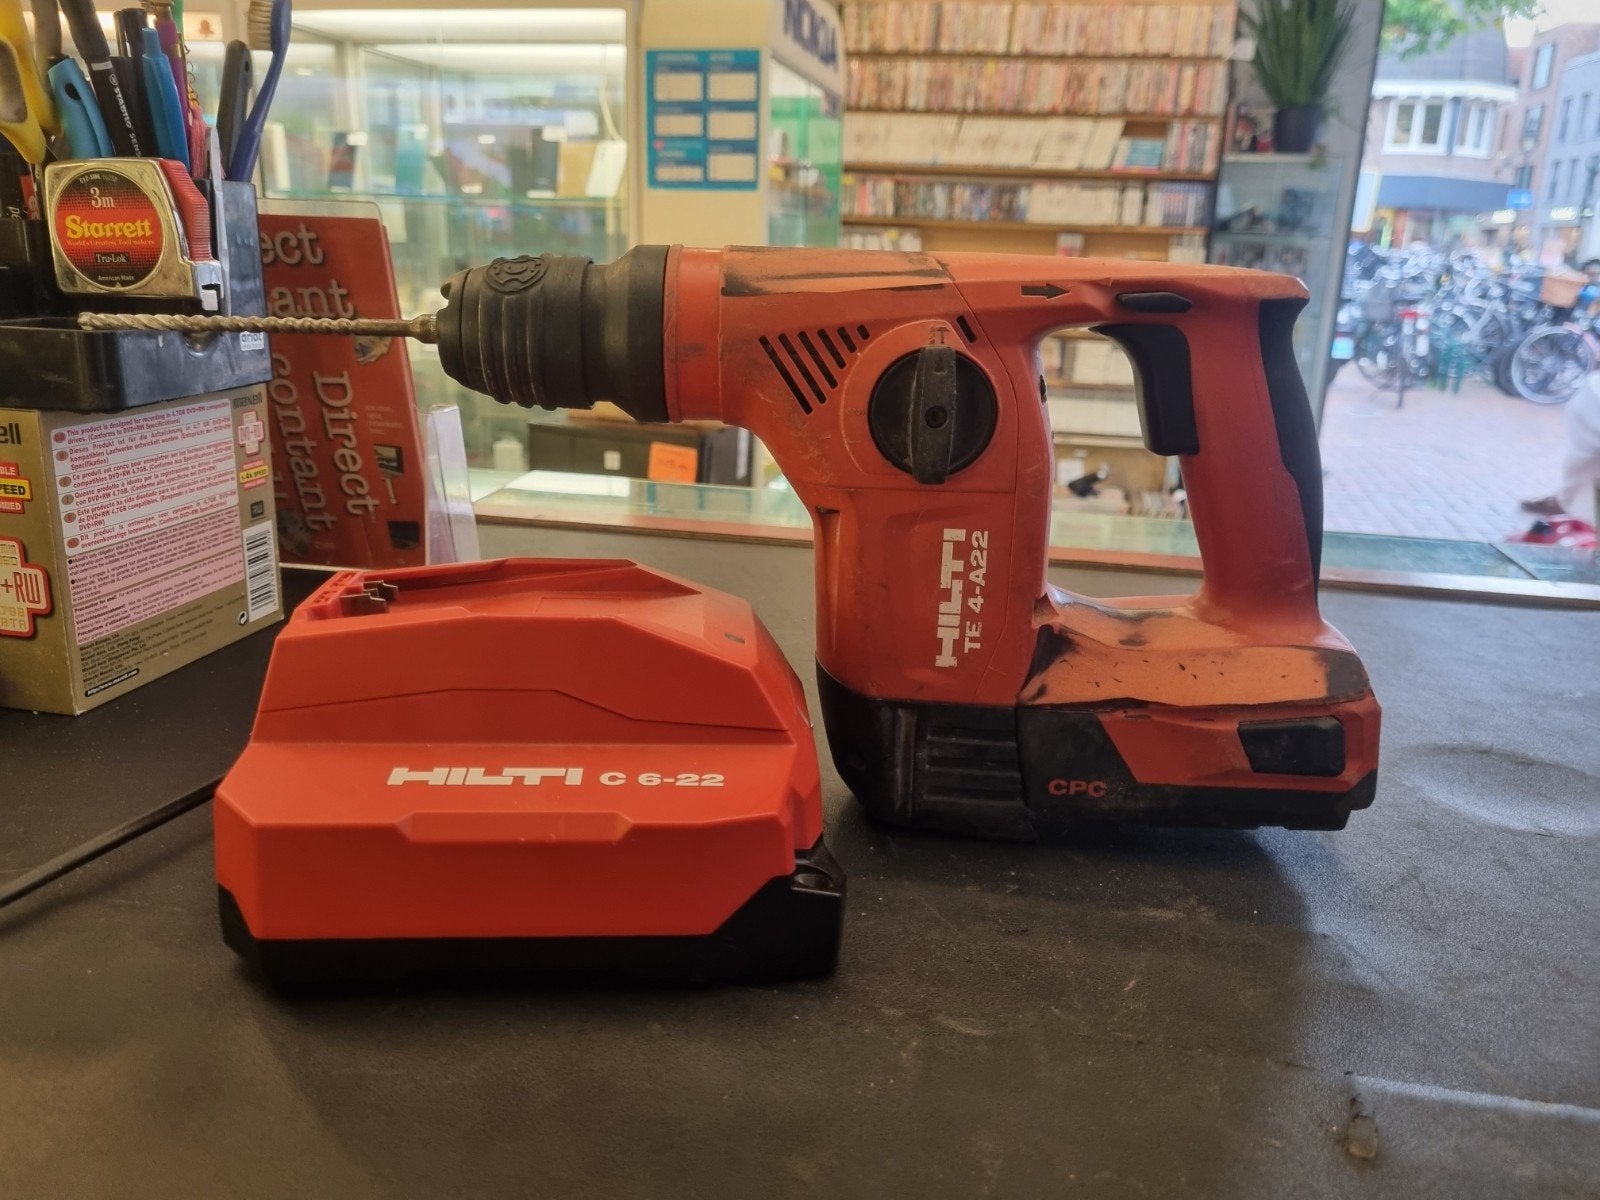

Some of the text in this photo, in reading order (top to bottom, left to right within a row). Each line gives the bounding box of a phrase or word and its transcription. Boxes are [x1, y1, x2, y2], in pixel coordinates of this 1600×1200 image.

[90, 186, 115, 208] 3m
[65, 214, 152, 239] Starrett
[96, 253, 127, 263] Tru-Lok
[267, 279, 355, 319] ant
[233, 392, 262, 409] maxell
[81, 425, 102, 435] product
[110, 419, 133, 430] designed
[143, 413, 165, 424] recording
[68, 435, 86, 444] drives.
[88, 430, 116, 441] (Conforms
[123, 424, 144, 434] DVD+RW
[69, 446, 88, 455] Dieses
[93, 440, 114, 450] Produkt
[311, 370, 381, 517] Direct
[70, 450, 105, 464] kompatiblen
[106, 444, 133, 455] Laufwerke
[74, 476, 107, 489] compatibles
[108, 471, 130, 480] DVD+RW
[82, 469, 102, 480] produit
[0, 484, 26, 496] EED
[75, 489, 95, 499] Questo
[97, 483, 120, 494] prodotto
[88, 492, 111, 503] DVD+RW
[77, 508, 90, 516] Este
[91, 502, 115, 514] producto
[86, 510, 110, 521] DVD+RW
[112, 506, 127, 514] 4.7GB
[79, 519, 105, 532] DVD+RW)
[93, 527, 115, 538] product
[935, 528, 966, 668] HILTI
[964, 529, 989, 654] TE 4-A22
[387, 767, 725, 787] HILTI C 6-22
[1047, 779, 1108, 798] CPC
